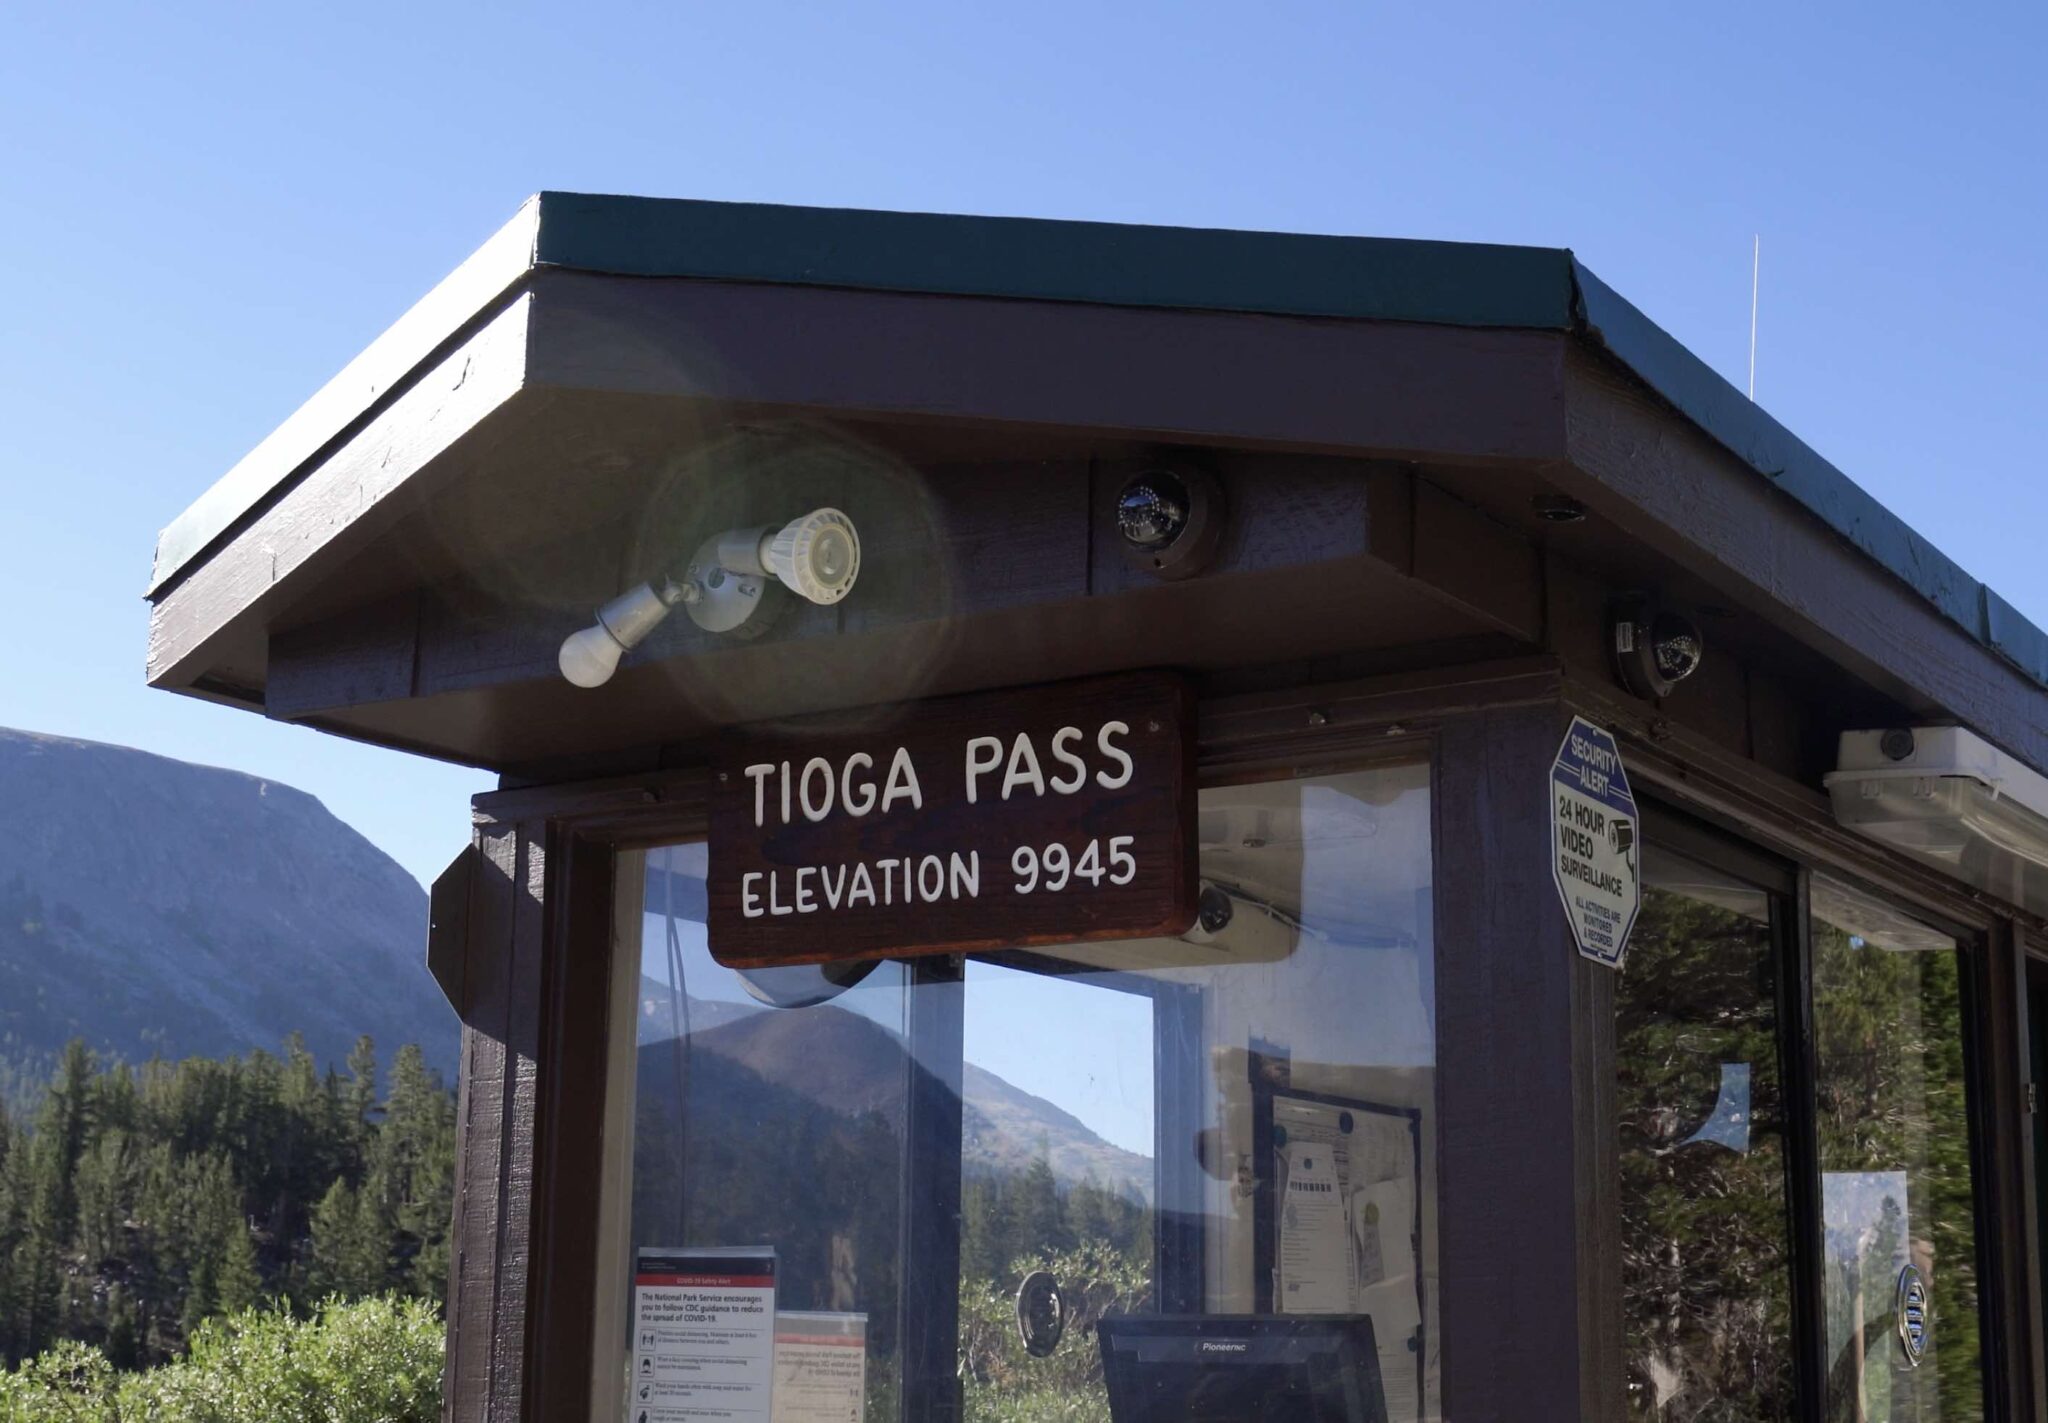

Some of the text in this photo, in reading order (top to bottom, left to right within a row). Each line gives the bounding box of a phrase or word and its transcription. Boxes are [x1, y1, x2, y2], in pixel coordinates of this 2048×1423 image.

[1571, 734, 1617, 776] SECURITY
[744, 720, 1135, 828] TIOGA PASS
[1580, 765, 1610, 798] ALERT
[1559, 794, 1605, 837] 24 HOUR
[1560, 823, 1594, 860] VIDEO
[742, 835, 1138, 919] ELEVATION 9945
[1561, 854, 1623, 898] SURVEILLANCE
[1575, 895, 1621, 924] ALL ACTIVITIES ARE
[1583, 912, 1613, 935] MONITORED
[642, 1292, 762, 1305] The National Park Service encourages
[654, 1303, 662, 1311] to
[662, 1303, 683, 1312] follow
[684, 1304, 699, 1312] CDC
[700, 1304, 730, 1313] guidance
[731, 1305, 739, 1313] to
[740, 1305, 764, 1313] reduce
[641, 1313, 652, 1321] the
[652, 1314, 674, 1323] spread
[675, 1313, 683, 1322] of
